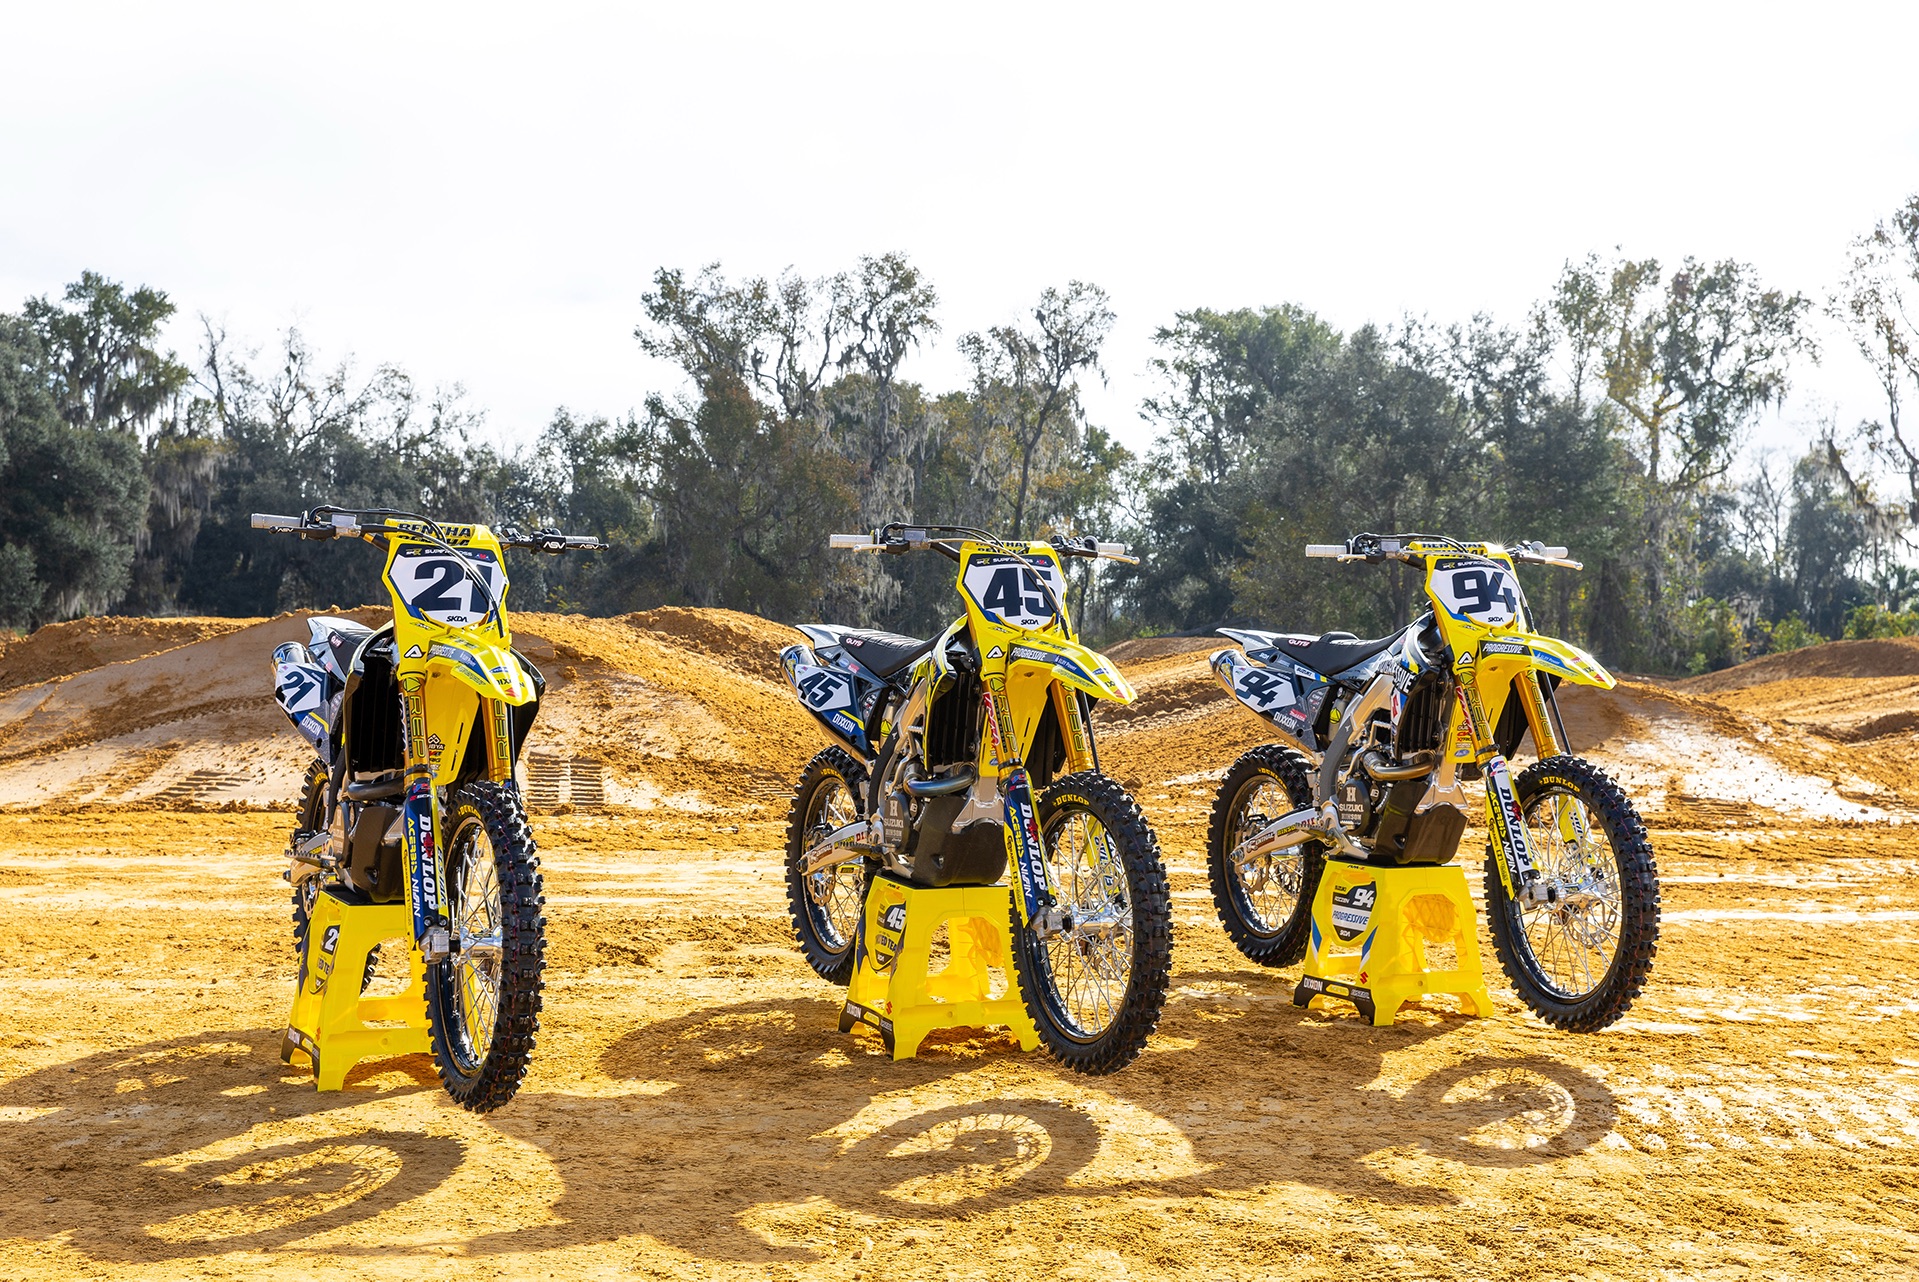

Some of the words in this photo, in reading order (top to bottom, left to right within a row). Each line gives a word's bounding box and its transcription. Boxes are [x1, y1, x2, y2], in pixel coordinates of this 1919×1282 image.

[543, 541, 566, 549] ASV
[411, 560, 492, 614] 21
[983, 567, 1057, 617] 45
[1452, 570, 1517, 614] 94
[846, 637, 864, 647] GUTS
[1011, 647, 1048, 661] PROGRESSIVE
[1288, 639, 1310, 647] GUTS
[1482, 643, 1525, 654] PROGRESSIVE
[281, 671, 316, 710] 21
[799, 671, 843, 708] 45
[1236, 670, 1284, 708] 94
[832, 713, 856, 734] DIXXON
[998, 695, 1018, 752] REP
[1066, 695, 1086, 752] REP
[1273, 711, 1298, 730] DIXXON
[1468, 686, 1491, 739] REP
[301, 715, 323, 737] DIXXON
[410, 696, 426, 758] REP
[493, 699, 509, 760] REP
[1542, 775, 1581, 793] DUNLOP
[1055, 794, 1090, 806] DUNLOP
[1338, 803, 1364, 813] SUZUKI
[883, 818, 904, 828] SUZUKI
[1341, 813, 1362, 821] HINSON
[1489, 791, 1507, 838] ACERBIS
[1500, 787, 1530, 866] DUNLOP
[1008, 806, 1025, 858] ACERBIS
[1277, 825, 1297, 837] HINSO
[407, 817, 421, 875] ACERBIS
[1502, 840, 1518, 874] NISSIN
[1019, 861, 1033, 898] NISSIN
[411, 878, 422, 918] NISSIN
[1352, 888, 1375, 908] 94
[887, 907, 907, 930] 45
[1332, 910, 1370, 925] PROGRESSIVE
[325, 927, 340, 952] 2
[1303, 977, 1324, 992] DIXXON
